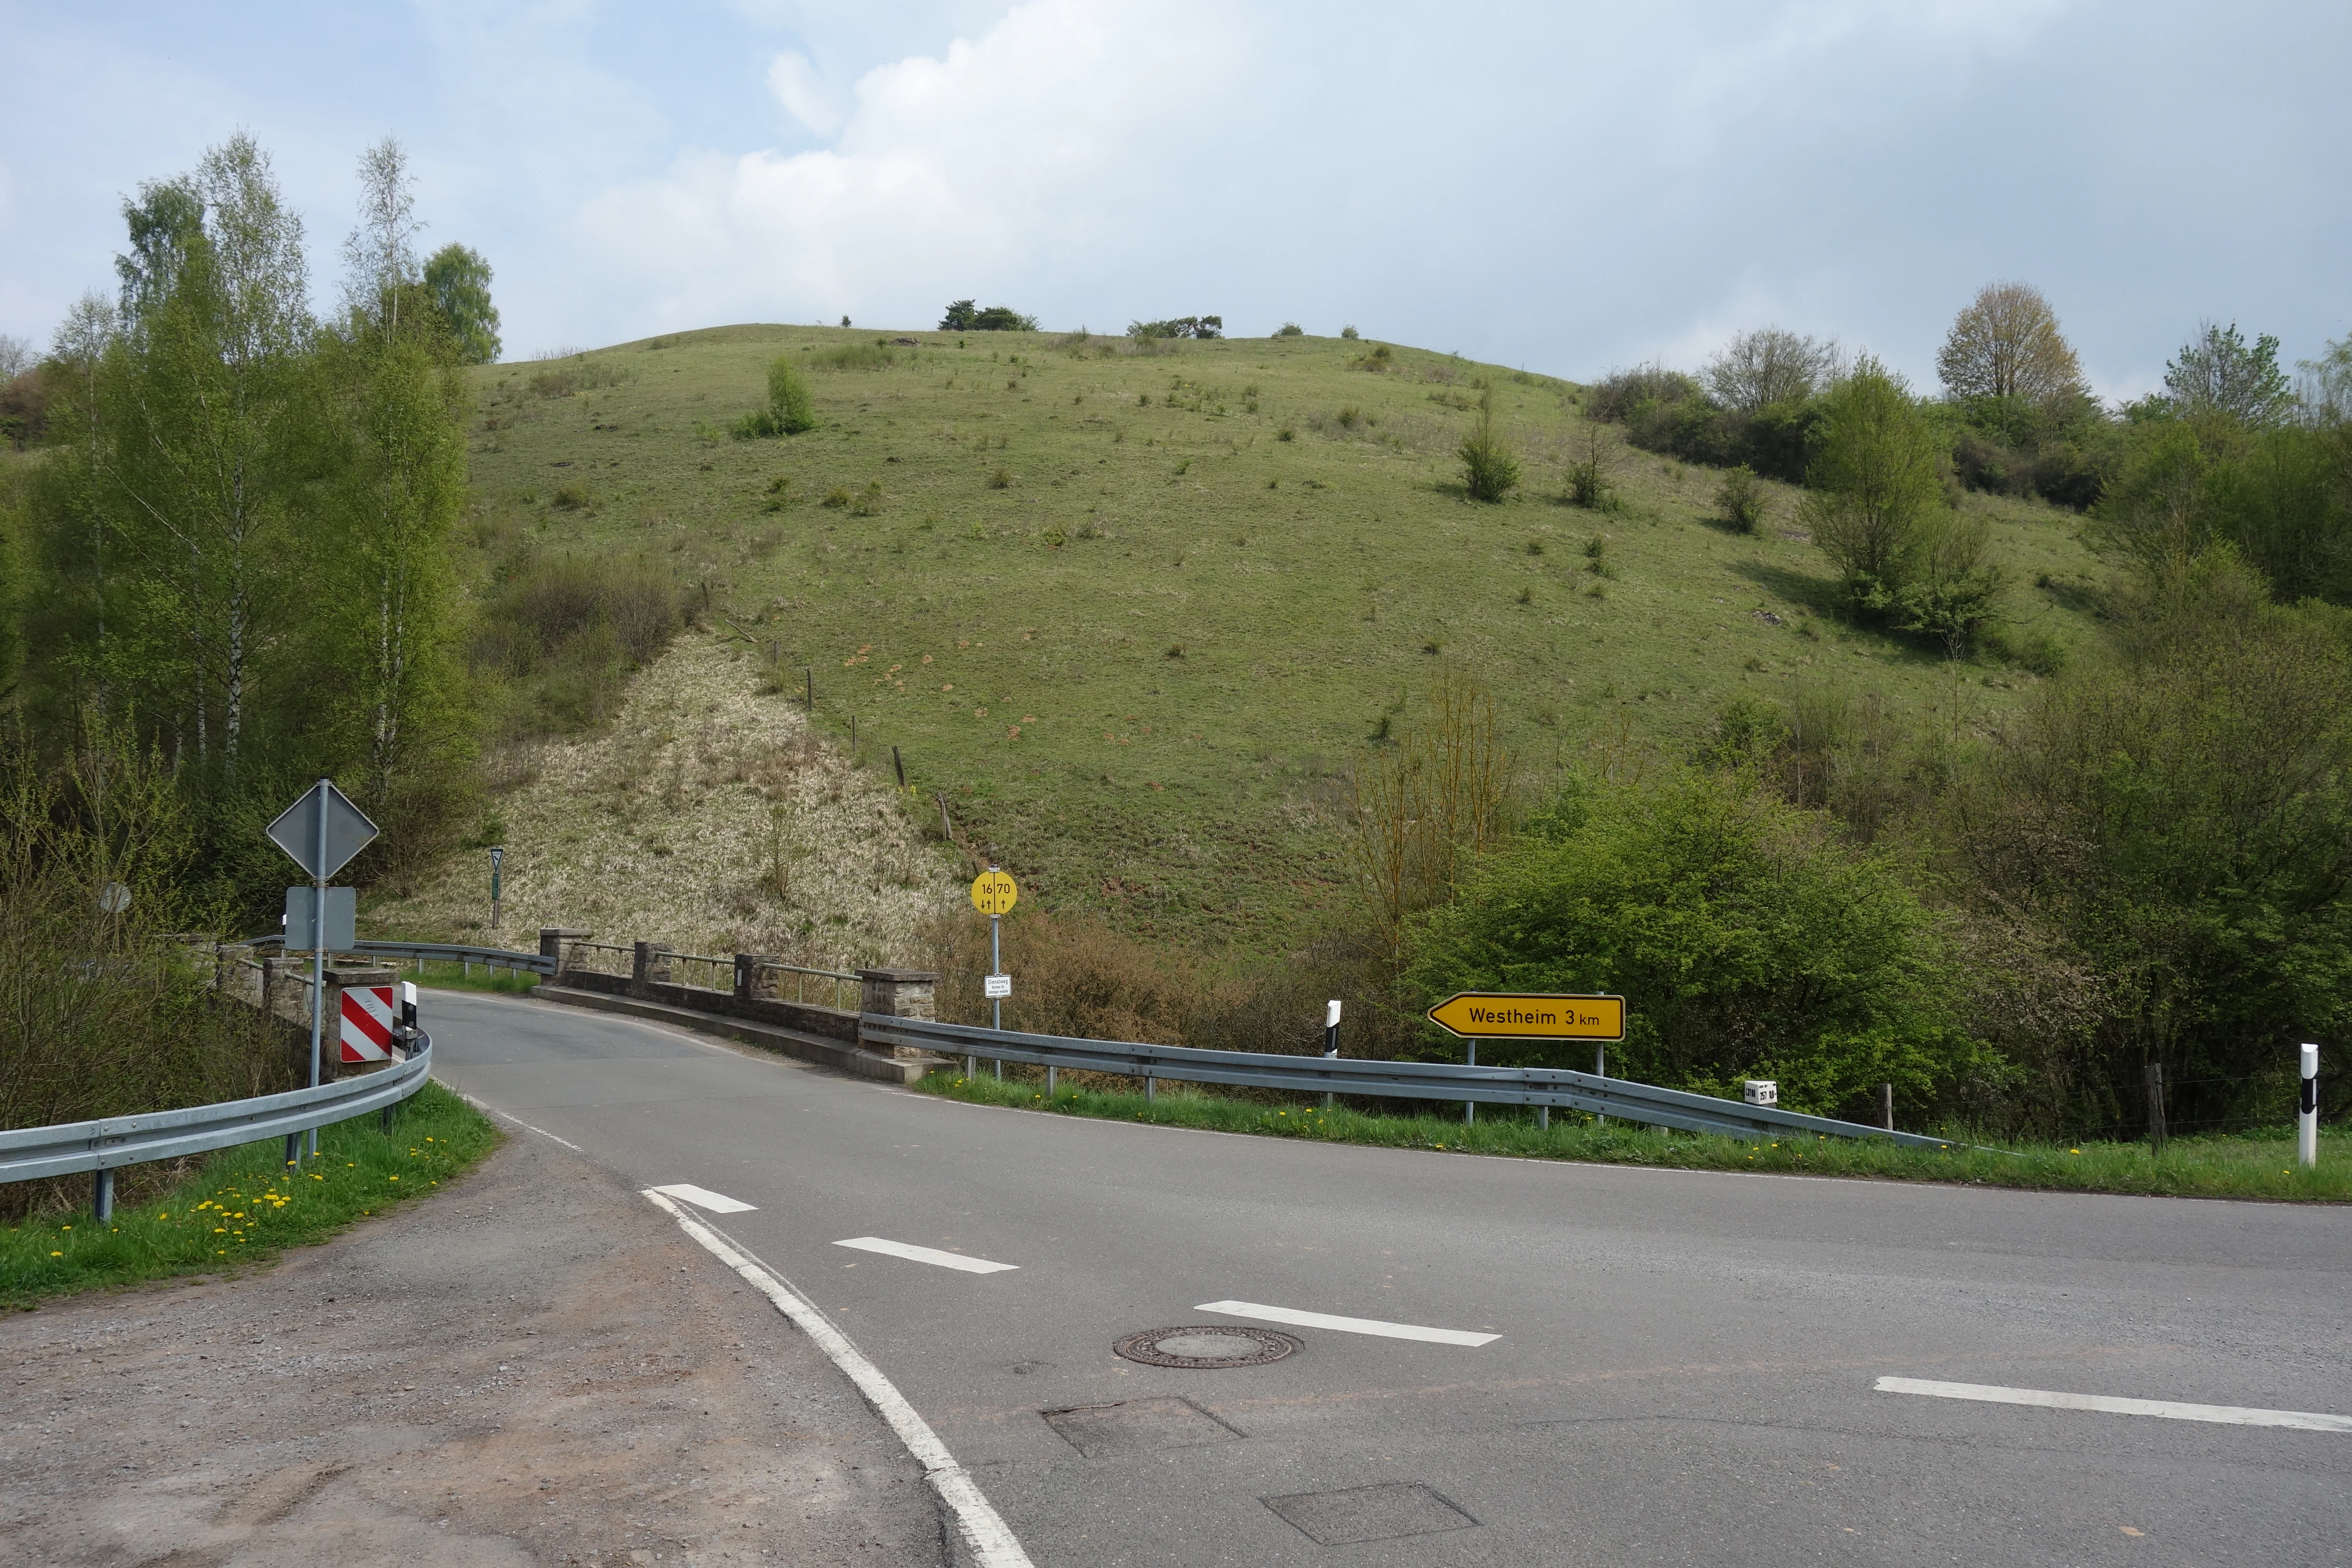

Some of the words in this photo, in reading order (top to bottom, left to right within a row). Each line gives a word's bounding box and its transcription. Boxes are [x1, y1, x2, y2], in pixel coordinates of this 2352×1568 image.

[982, 884, 992, 894] 16
[997, 884, 1010, 894] 70
[1469, 1008, 1556, 1024] Westheim
[1565, 1010, 1574, 1025] 3
[1580, 1014, 1599, 1025] km
